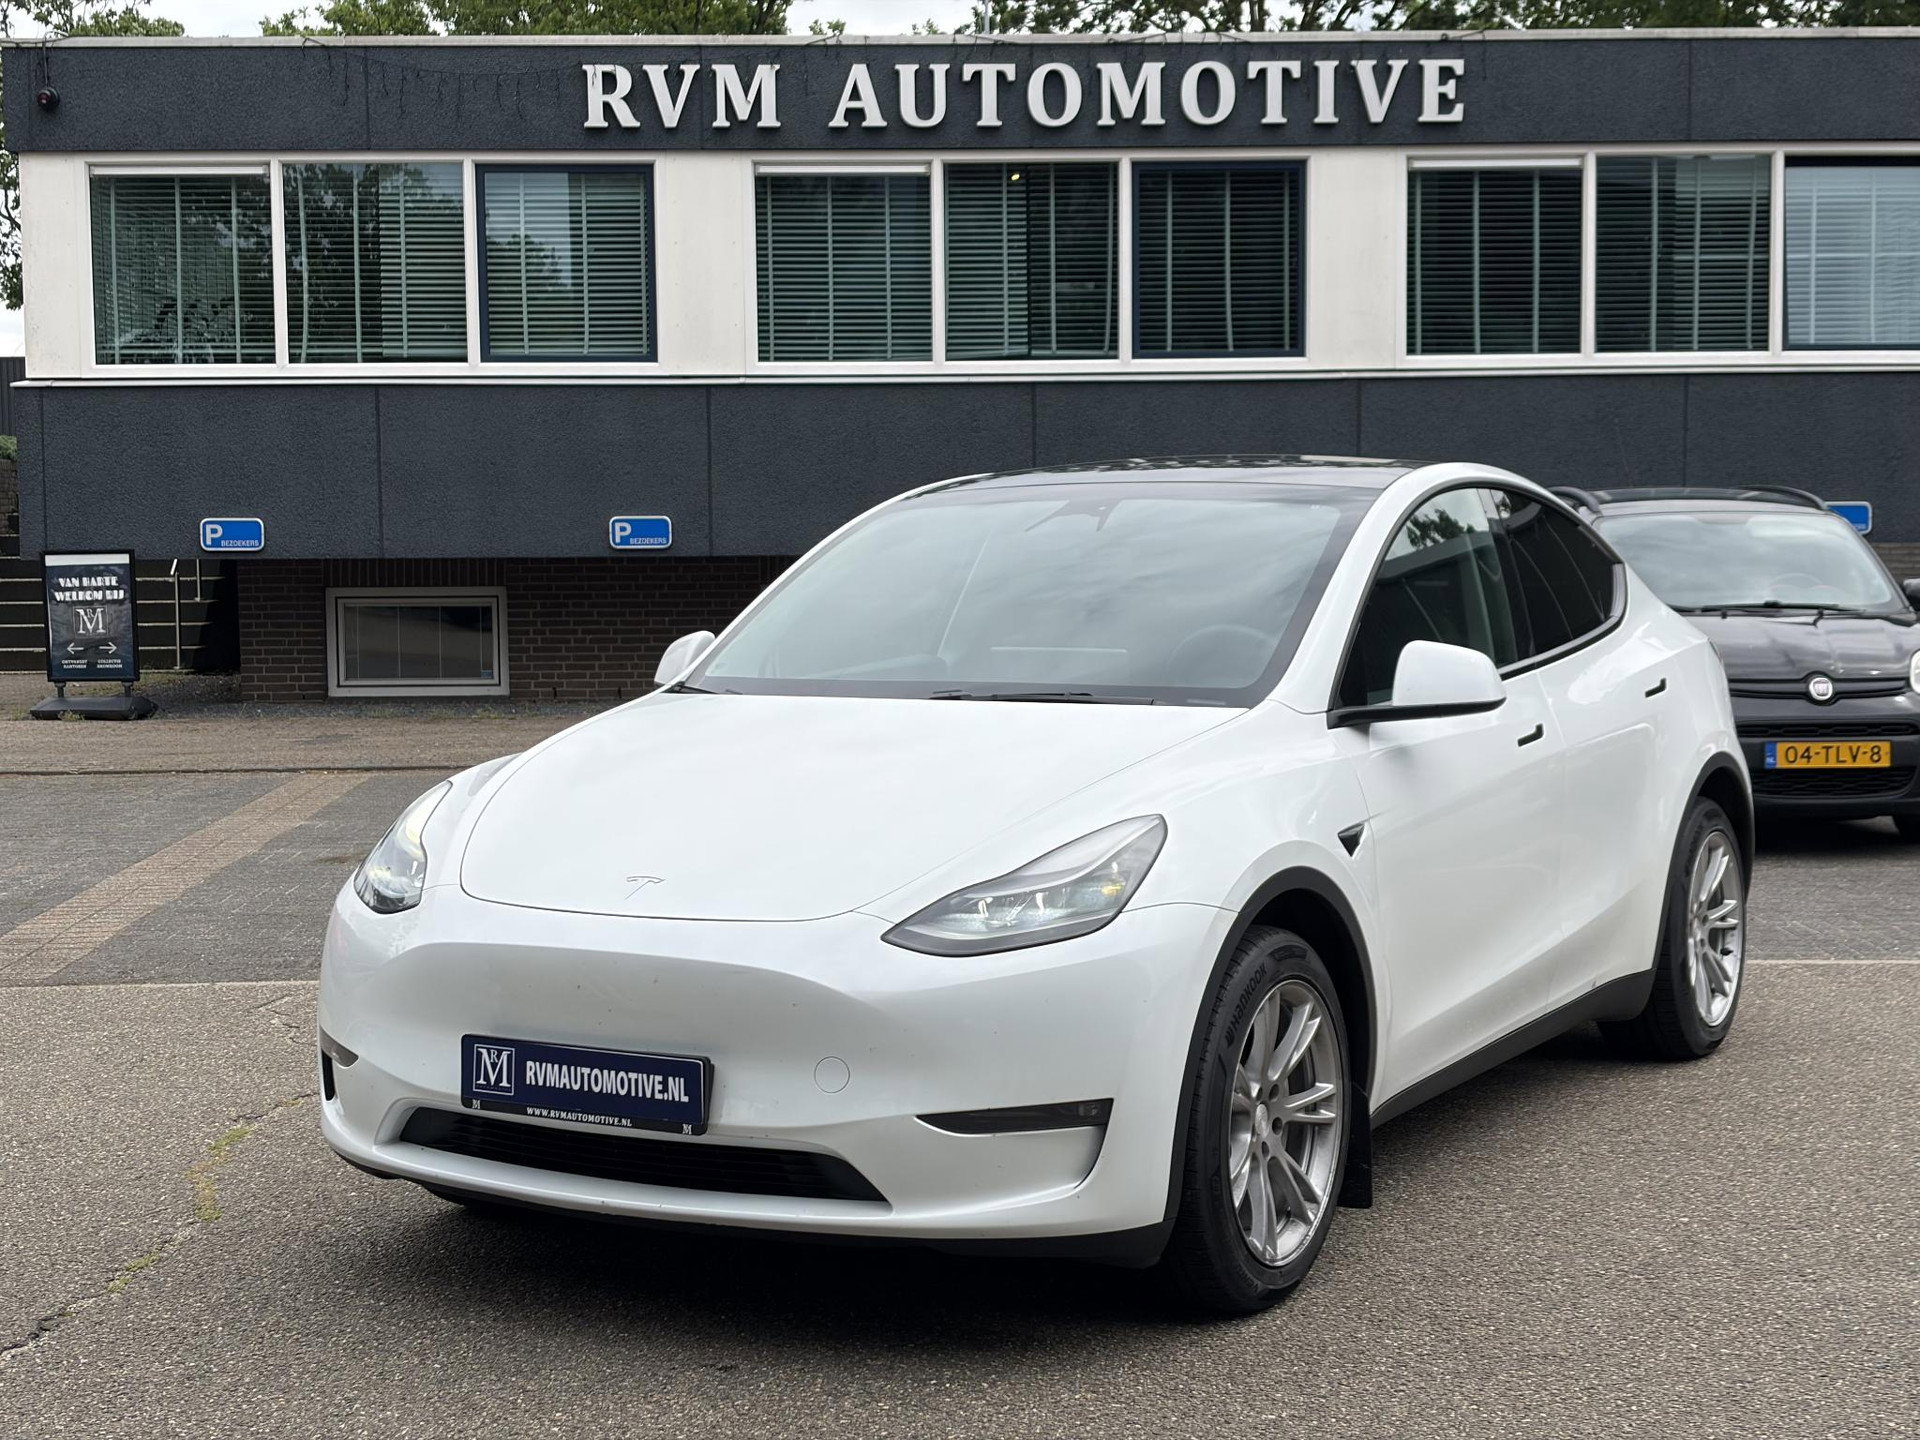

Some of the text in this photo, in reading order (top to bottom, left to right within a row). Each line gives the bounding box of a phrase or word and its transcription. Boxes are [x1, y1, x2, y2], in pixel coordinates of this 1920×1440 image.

[581, 58, 1466, 129] RVM AUTOMOTIVE
[205, 523, 223, 546] P
[614, 521, 632, 544] P
[58, 577, 80, 588] VAN
[54, 590, 103, 602] WELKOM
[1784, 744, 1882, 764] 04-TLV-8
[525, 1060, 690, 1103] RVMAUTOMOTIVE.NL
[526, 1106, 633, 1127] WWW.RVMAUTOMOTIVE.NL
